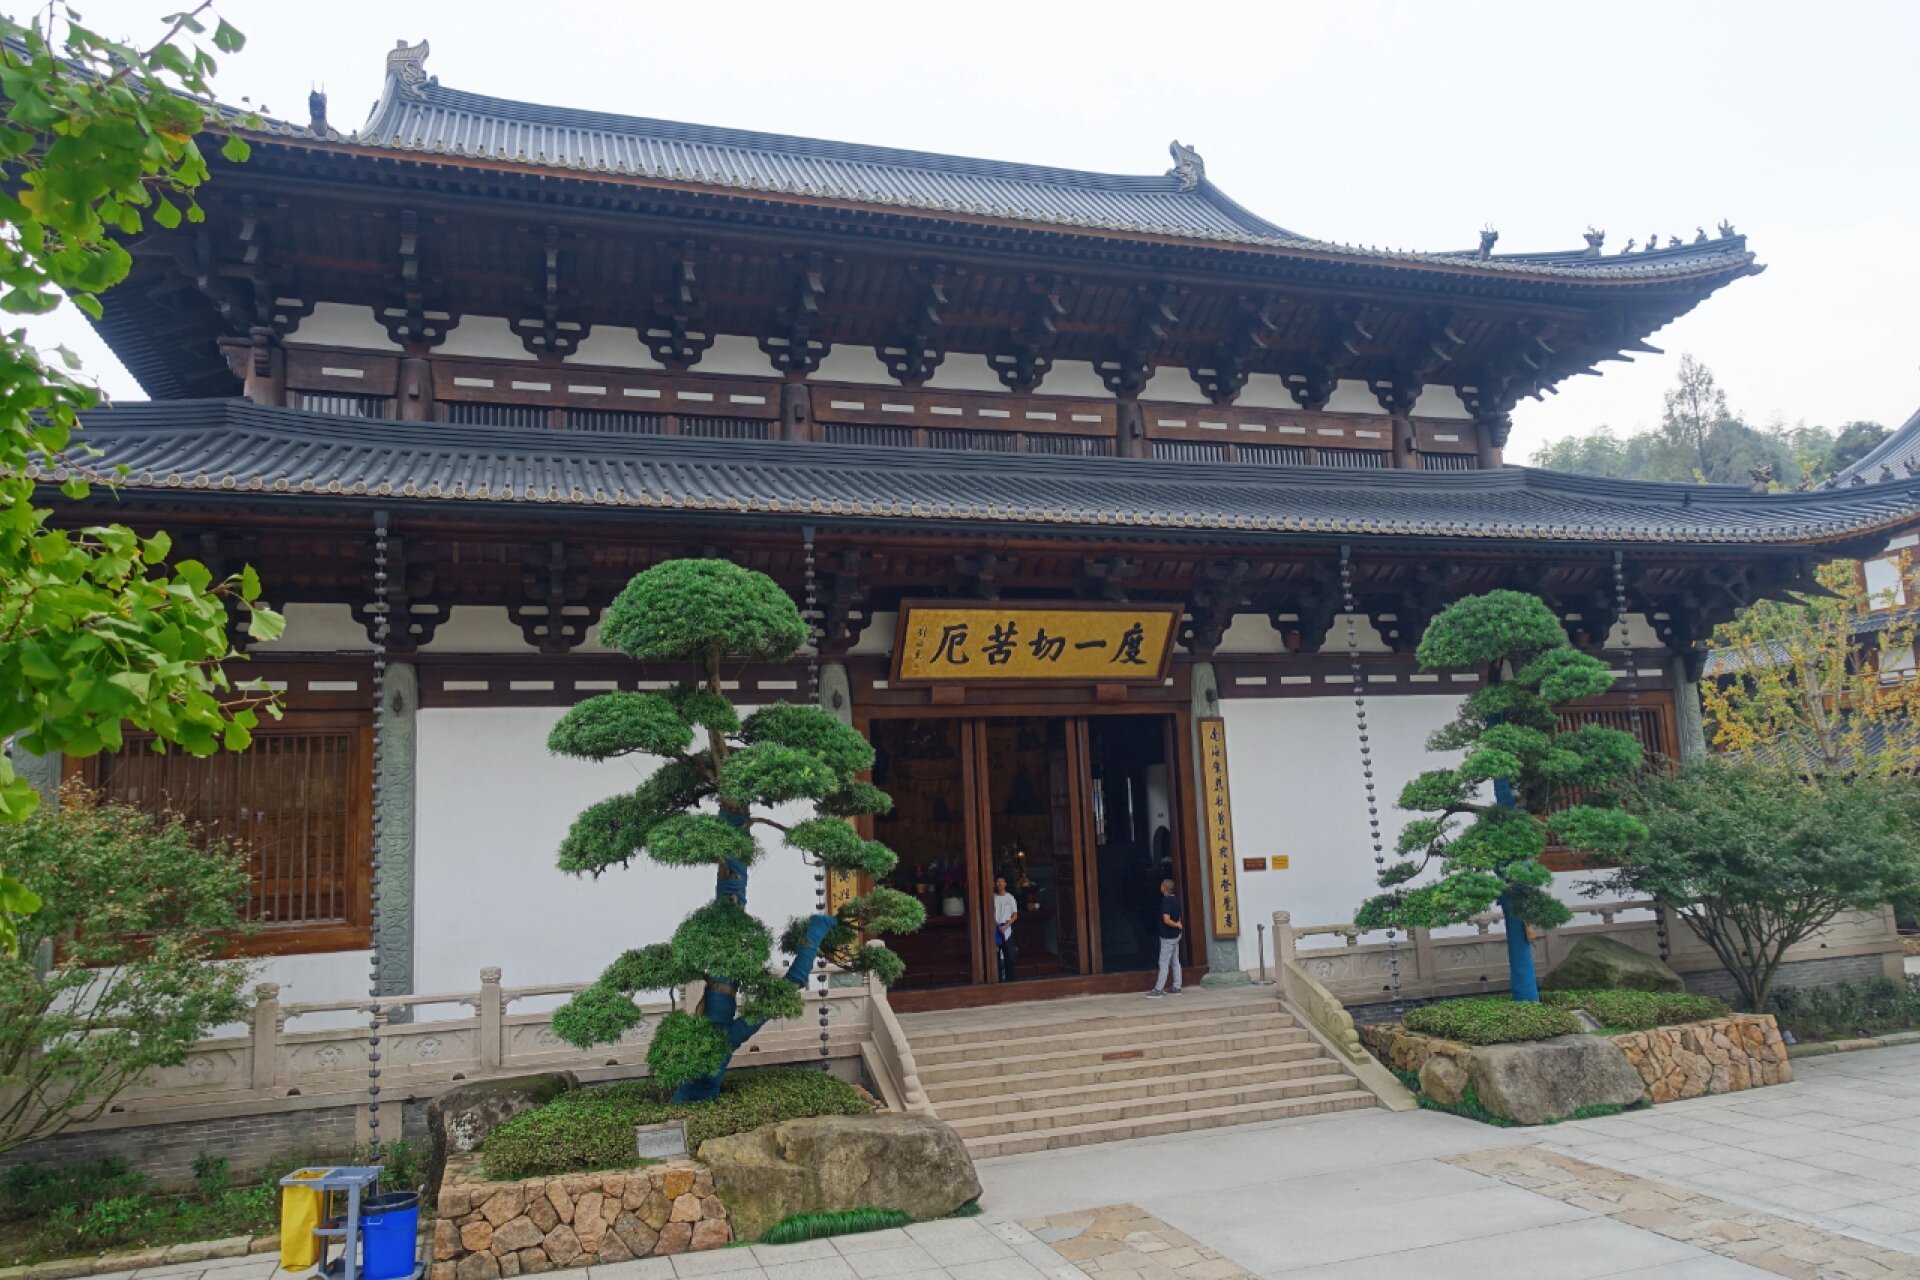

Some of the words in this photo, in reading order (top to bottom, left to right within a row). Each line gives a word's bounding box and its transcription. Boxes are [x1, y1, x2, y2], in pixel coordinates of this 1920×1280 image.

[930, 620, 1148, 666] 度一切苦厄
